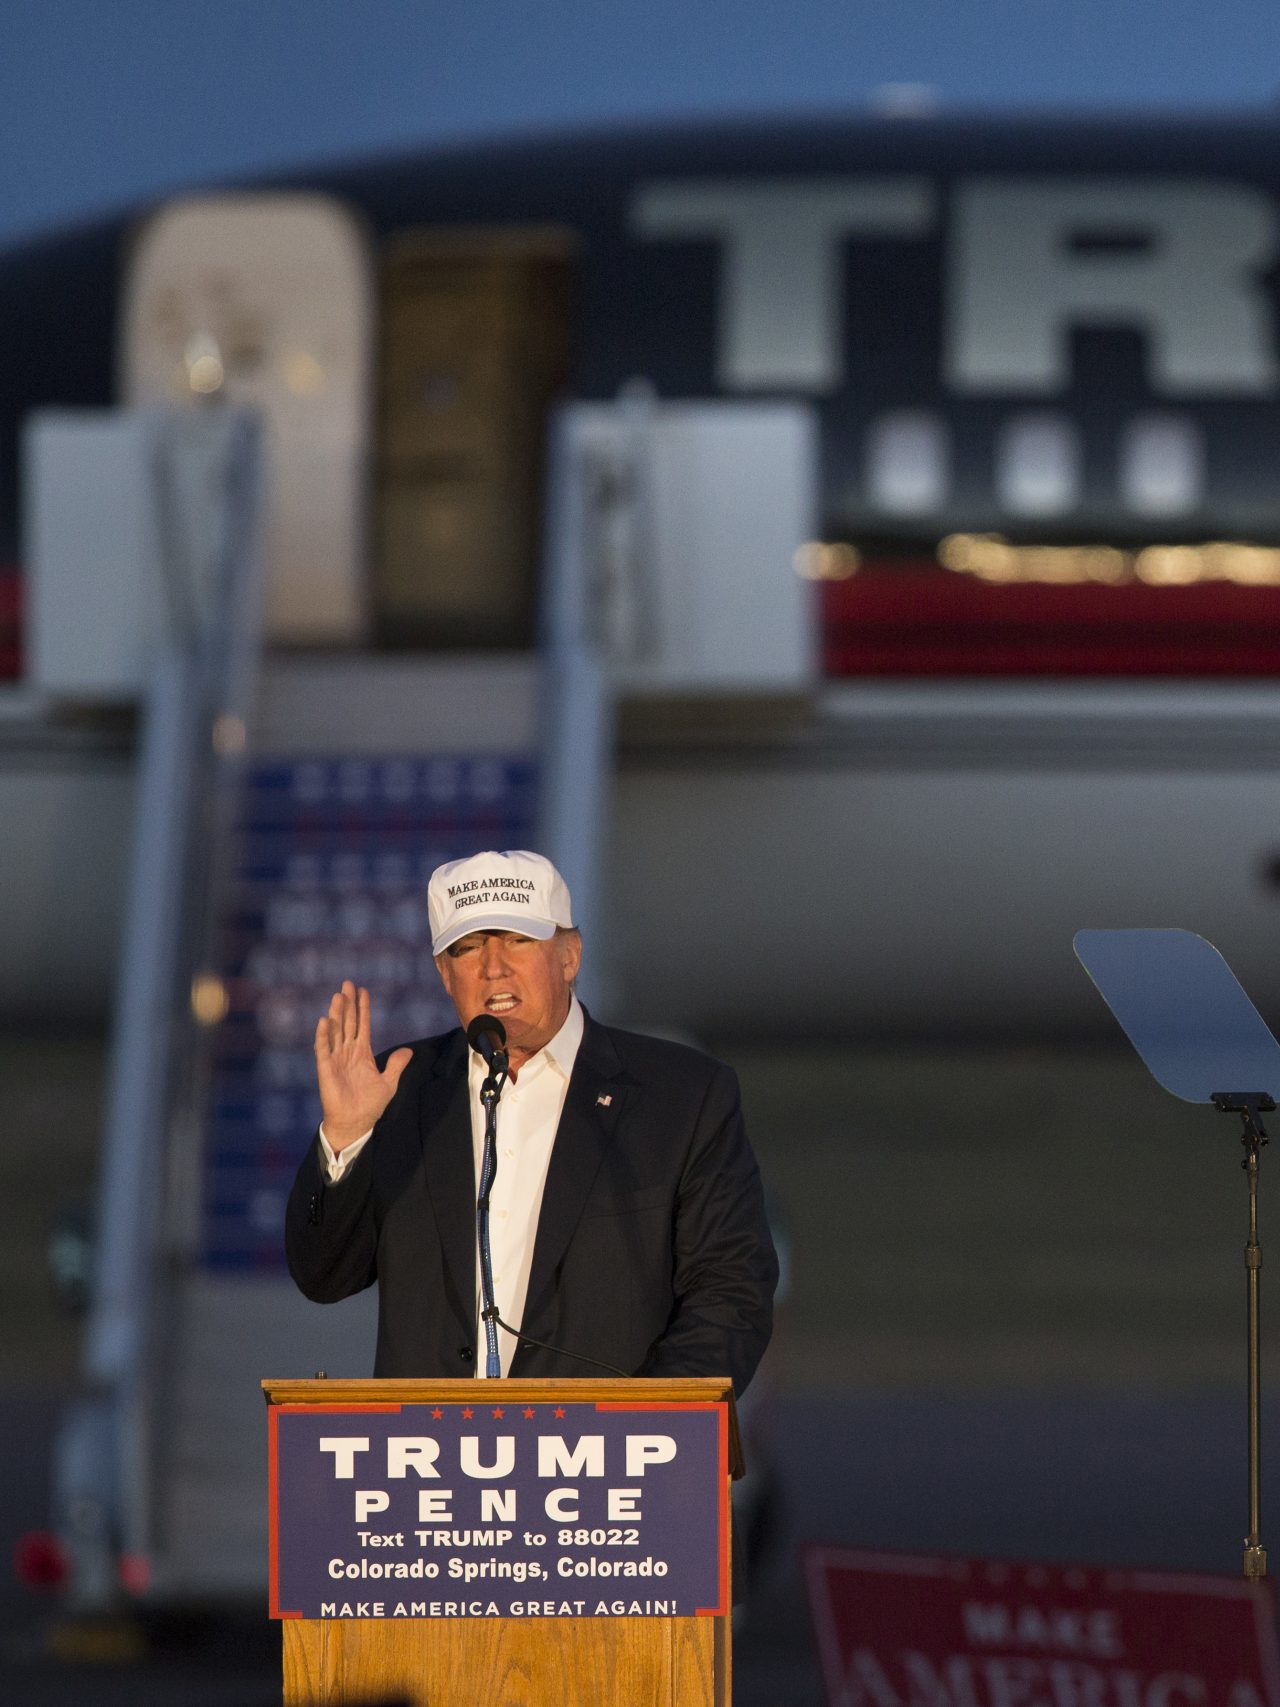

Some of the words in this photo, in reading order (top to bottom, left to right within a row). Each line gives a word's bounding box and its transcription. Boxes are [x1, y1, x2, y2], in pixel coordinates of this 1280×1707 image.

[447, 880, 479, 898] MAKE
[480, 877, 535, 891] AMERICA
[454, 892, 490, 909] GREAT
[492, 891, 530, 905] AGAIN
[319, 1434, 677, 1480] TRUMP
[355, 1487, 642, 1523] PENCE
[357, 1530, 404, 1547] Text
[415, 1530, 513, 1547] TRUMP
[523, 1531, 547, 1546] to
[557, 1528, 640, 1546] 88022
[328, 1558, 440, 1579] Colorado
[447, 1557, 549, 1583] Springs,
[557, 1556, 669, 1578] Colorado
[321, 1602, 385, 1617] MAKE
[393, 1601, 500, 1617] AMERICA
[509, 1600, 586, 1616] GREAT
[594, 1600, 678, 1615] AGAIN!
[962, 1601, 1124, 1658] MAKE
